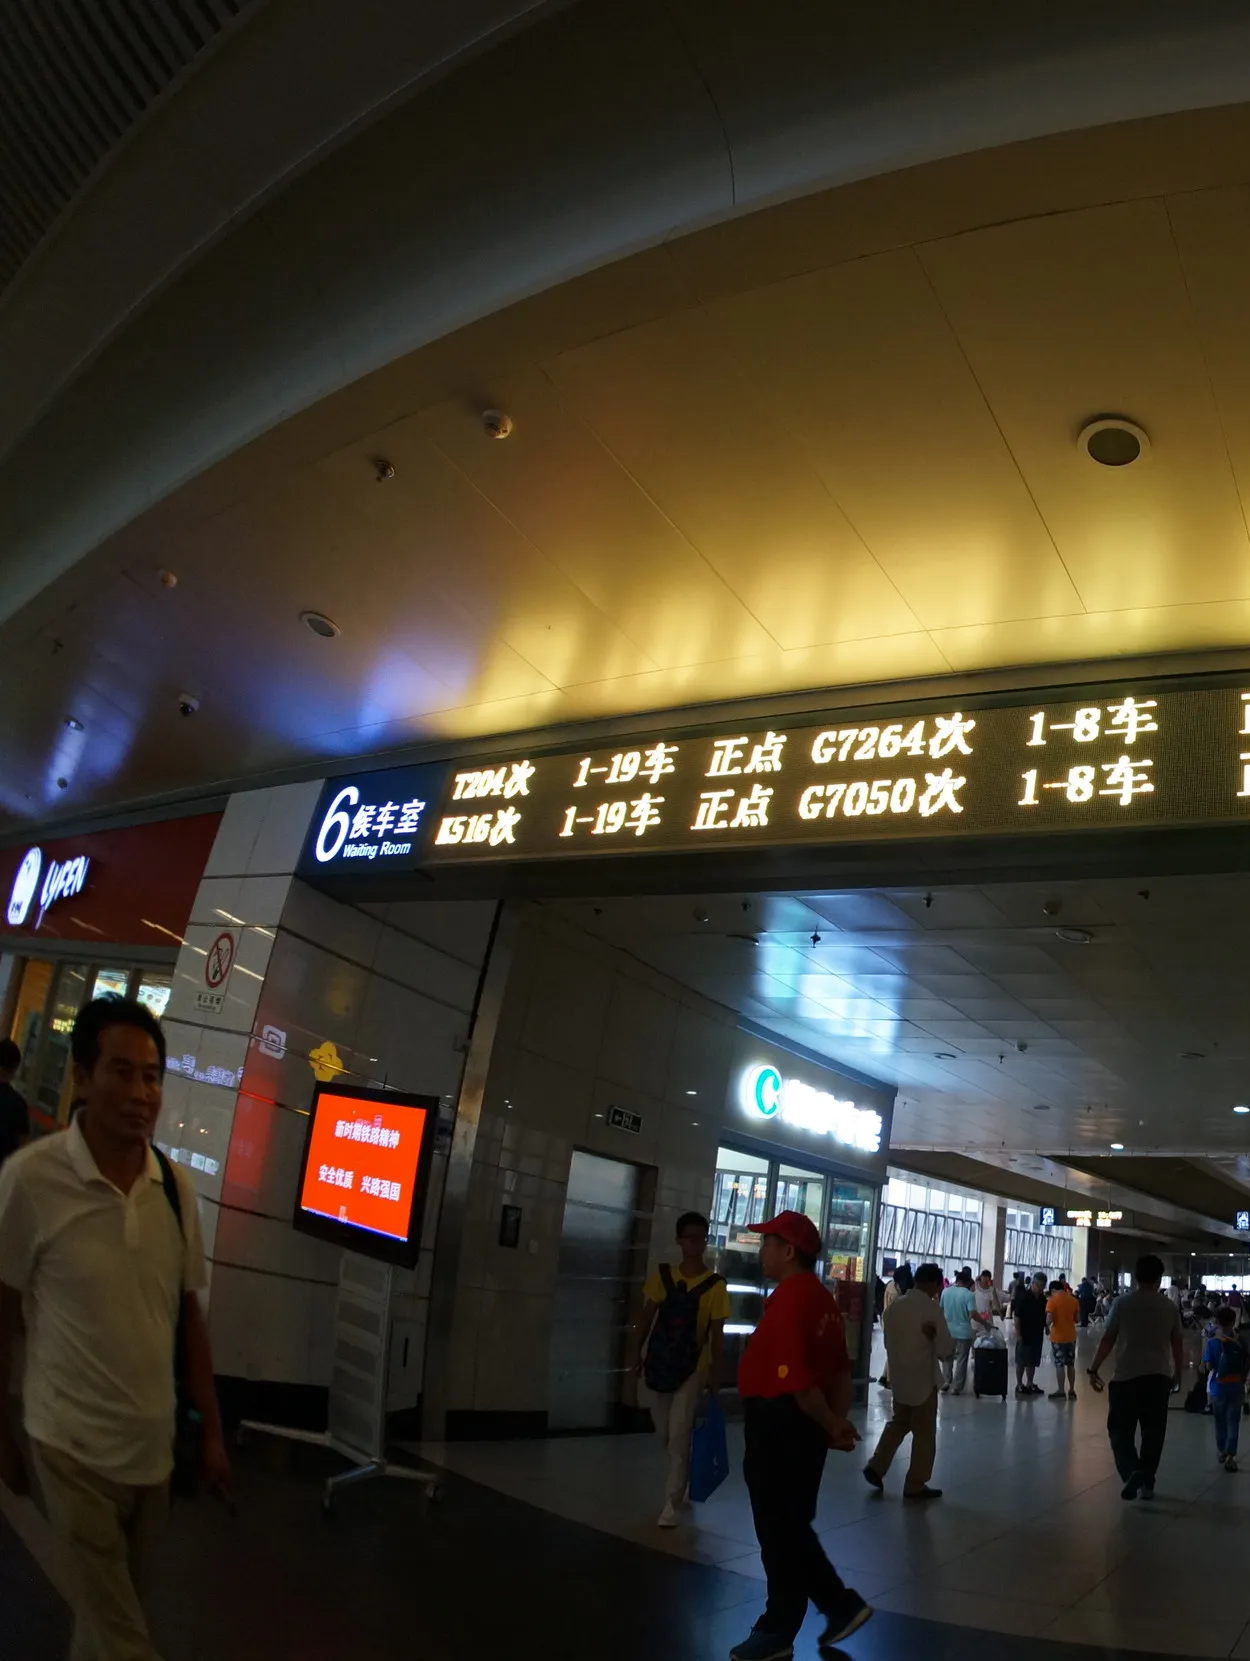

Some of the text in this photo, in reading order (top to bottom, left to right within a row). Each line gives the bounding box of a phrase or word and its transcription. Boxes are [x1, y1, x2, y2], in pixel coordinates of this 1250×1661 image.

[452, 760, 536, 800] T204次
[573, 742, 680, 787] 1-19车
[705, 731, 787, 777] 正点
[811, 712, 976, 764] G7264次
[1026, 697, 1158, 746] 1-8车
[315, 785, 360, 863] 6
[348, 798, 426, 839] 候车室
[559, 793, 666, 837] 1-19车
[690, 783, 770, 831] 正点
[798, 768, 967, 820] G7050次
[1018, 755, 1154, 806] 1-8车
[342, 841, 412, 860] Waiting Room
[317, 1164, 402, 1202] 安全优质 兴路强国
